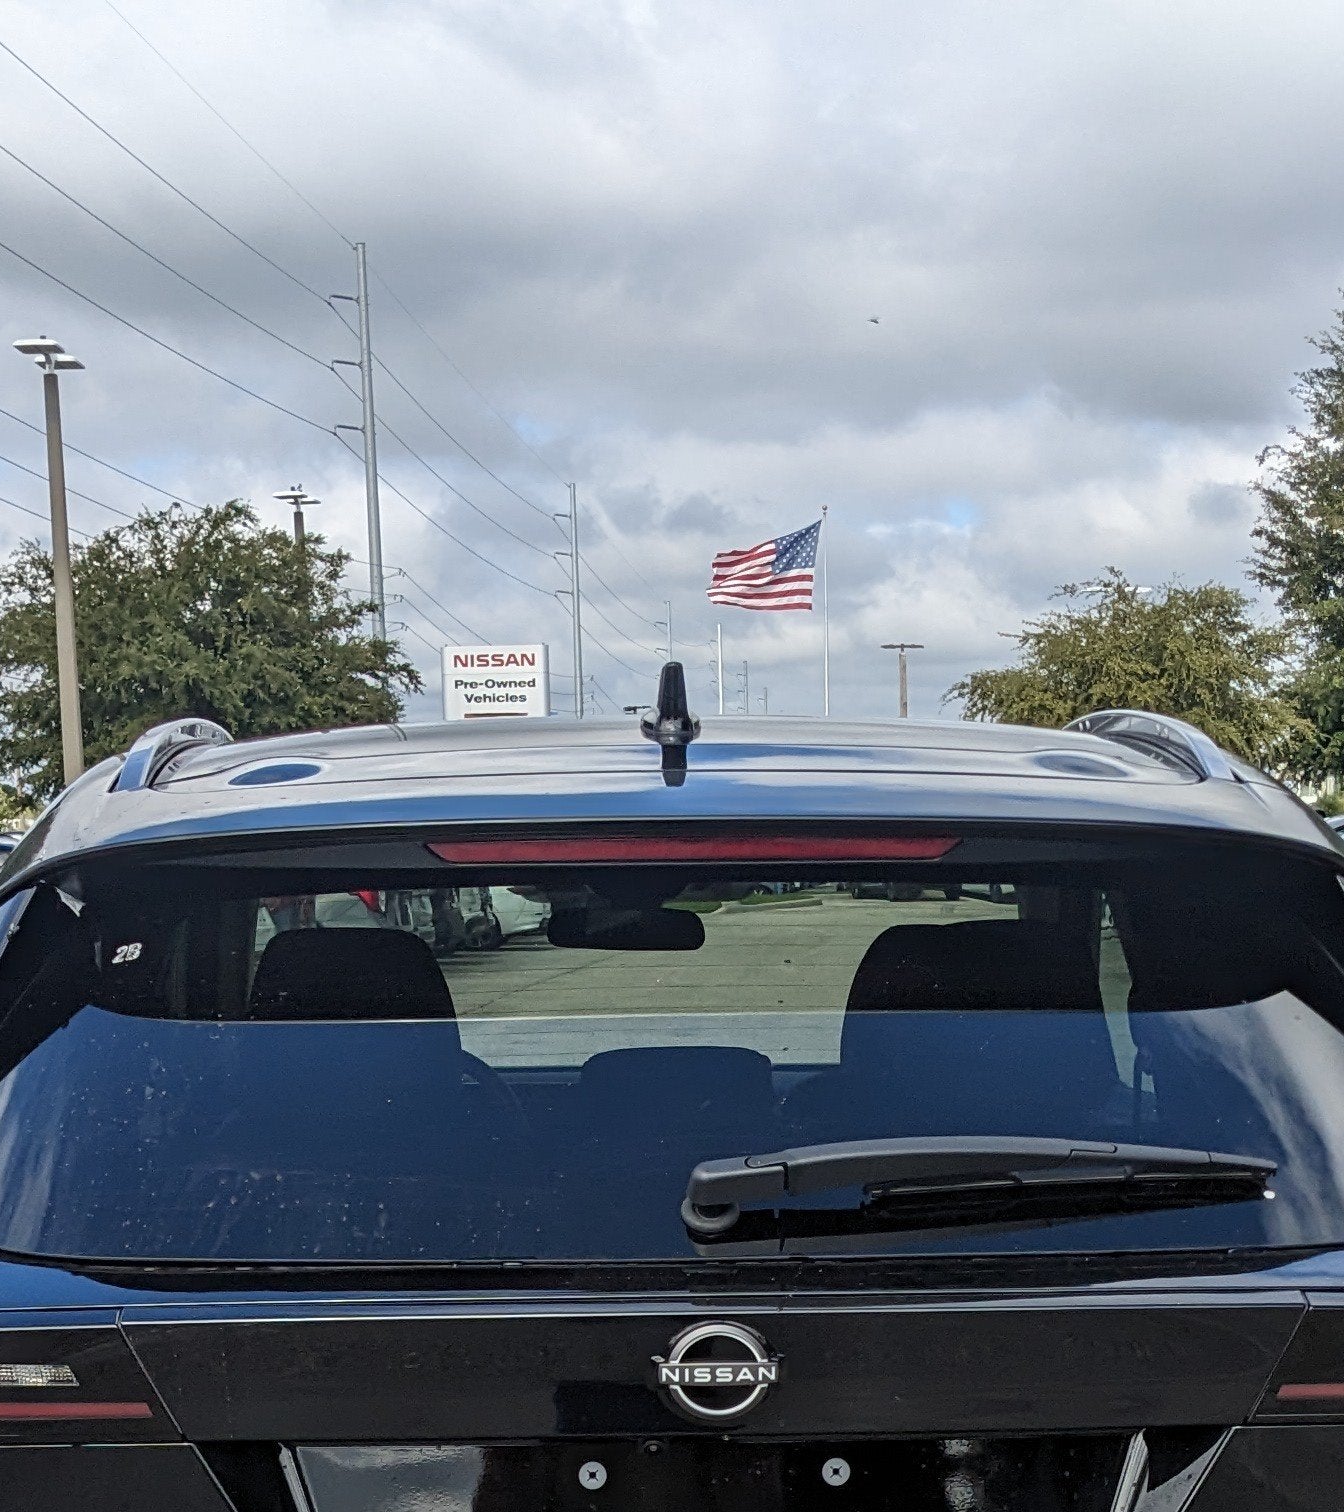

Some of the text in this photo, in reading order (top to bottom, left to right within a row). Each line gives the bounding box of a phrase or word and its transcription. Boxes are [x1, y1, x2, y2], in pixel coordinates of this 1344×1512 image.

[453, 653, 536, 668] NISSAN
[454, 678, 536, 690] Pre-Owned
[464, 693, 527, 703] Vehicles
[661, 1366, 776, 1383] NISSAN
